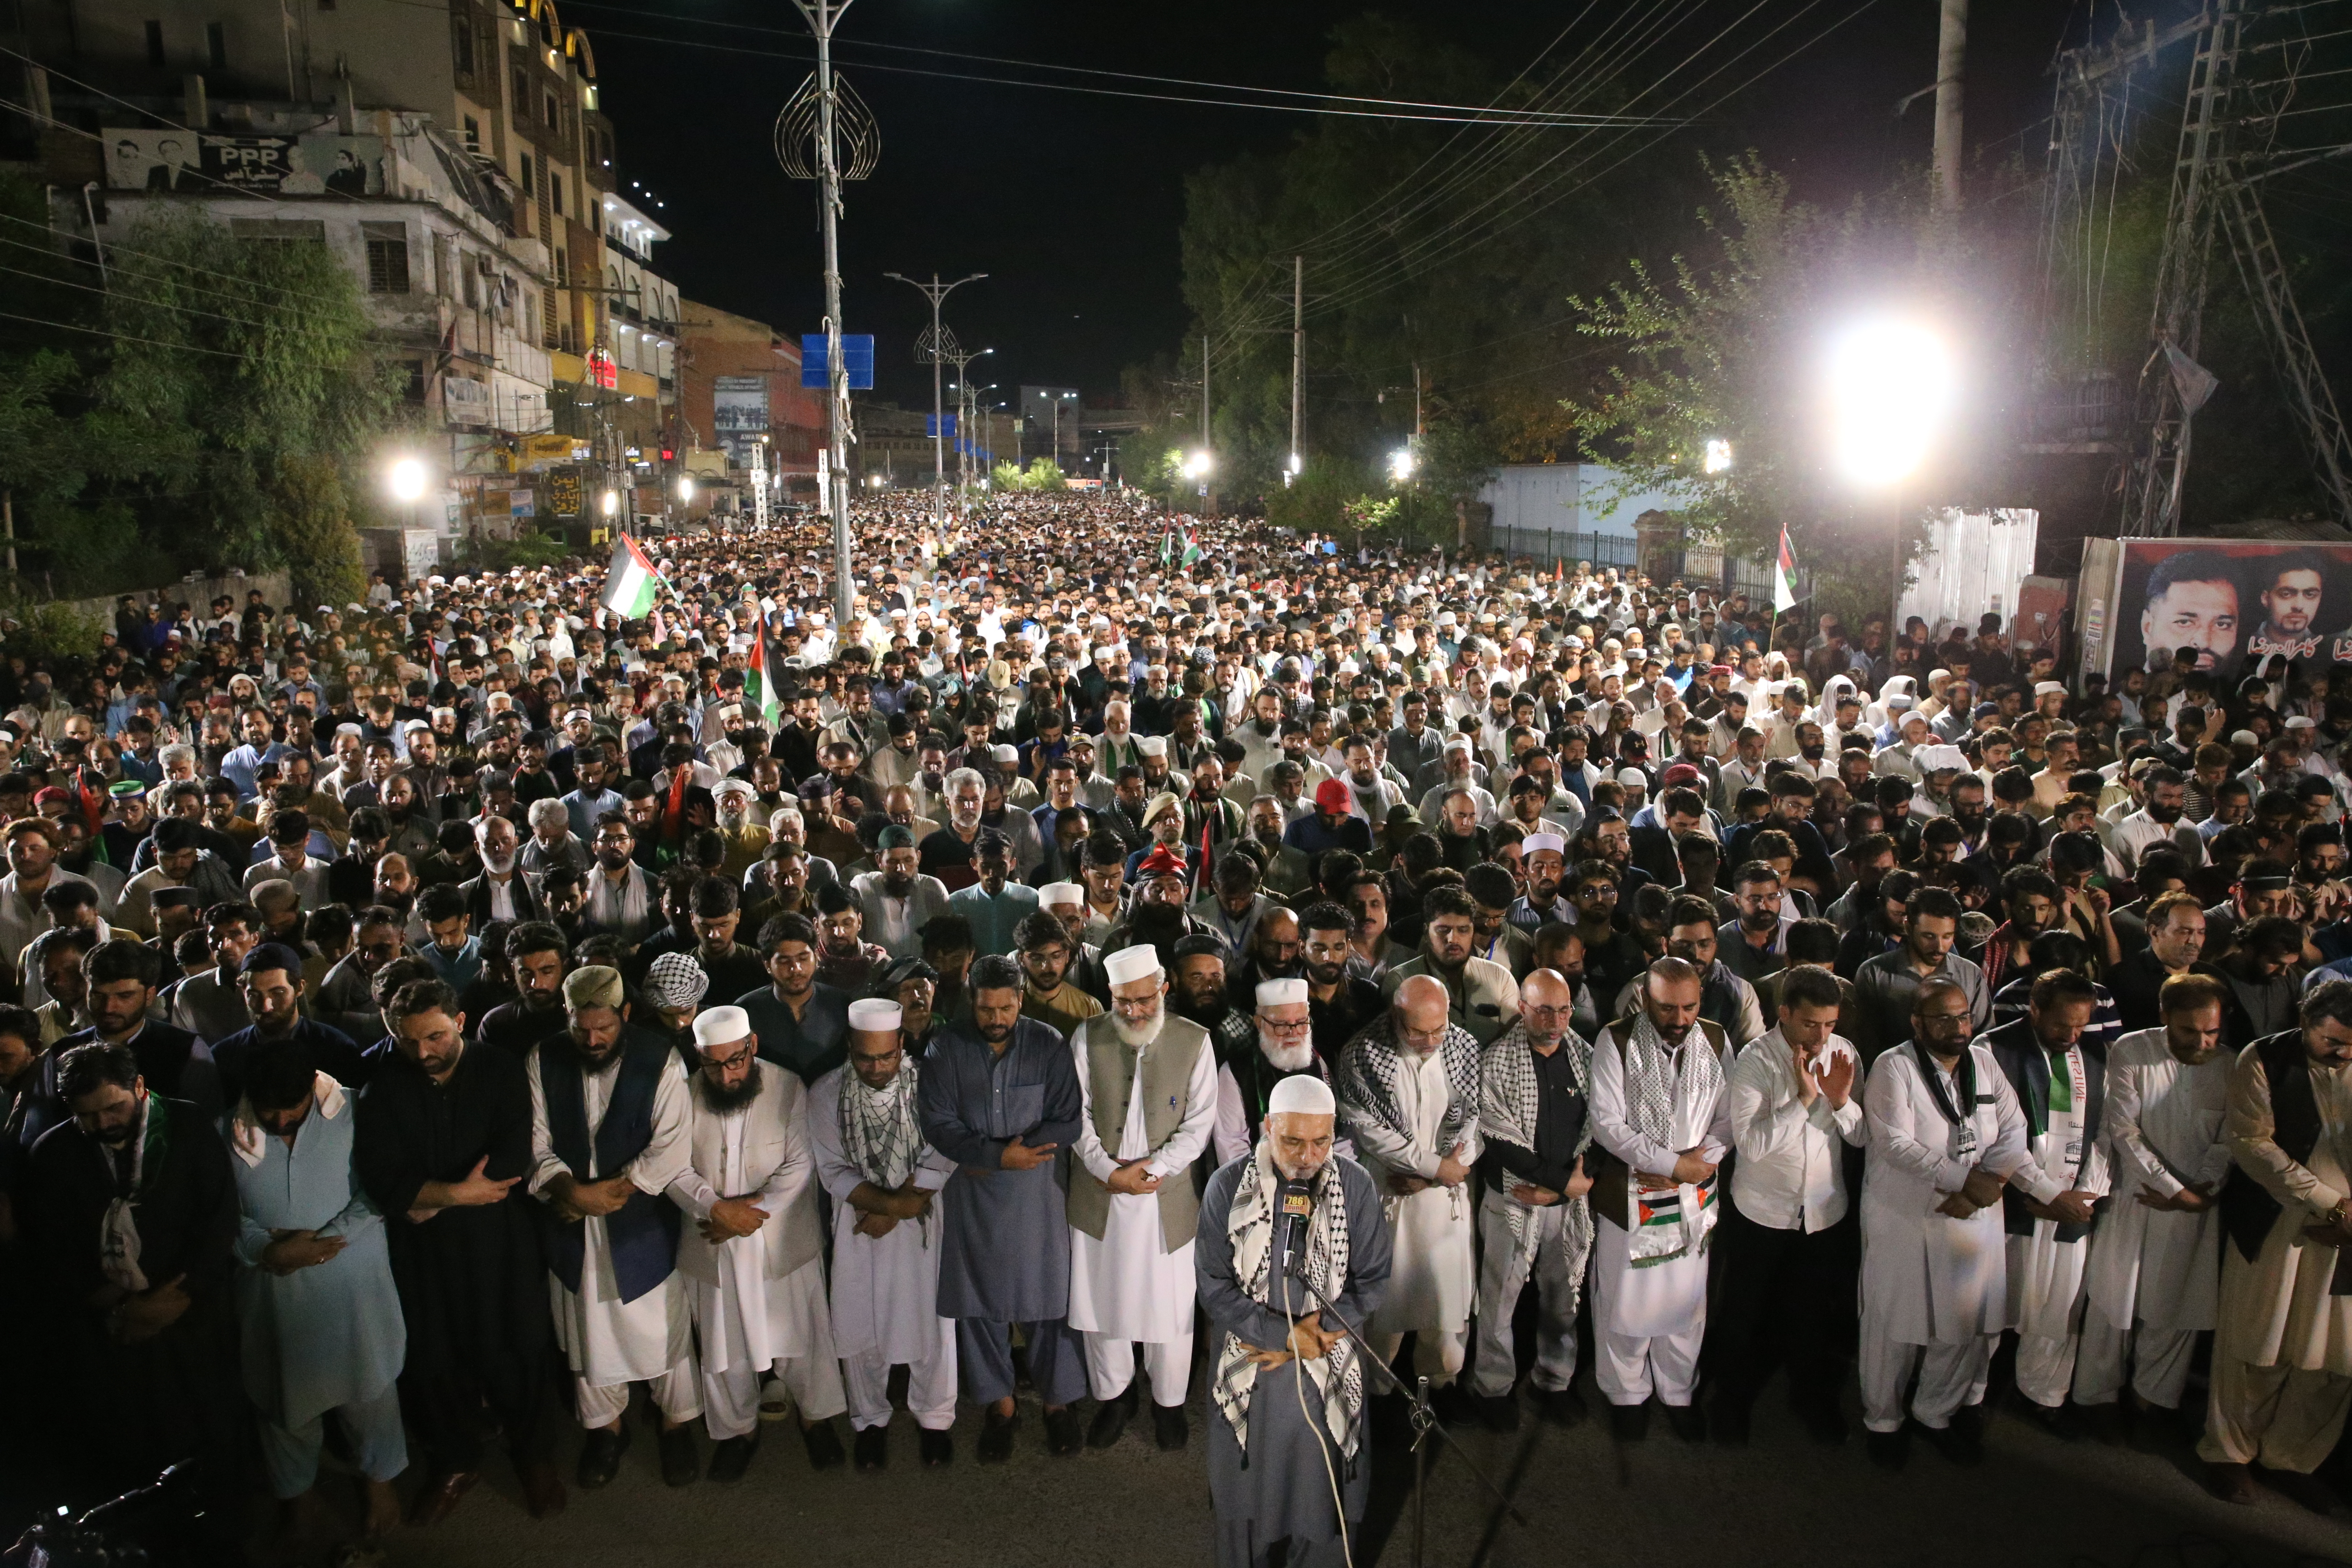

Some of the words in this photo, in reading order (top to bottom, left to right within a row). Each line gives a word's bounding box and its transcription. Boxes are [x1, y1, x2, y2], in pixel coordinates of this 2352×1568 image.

[220, 147, 279, 166] PPP
[552, 475, 579, 489] ایمن
[1288, 1196, 1303, 1205] 786
